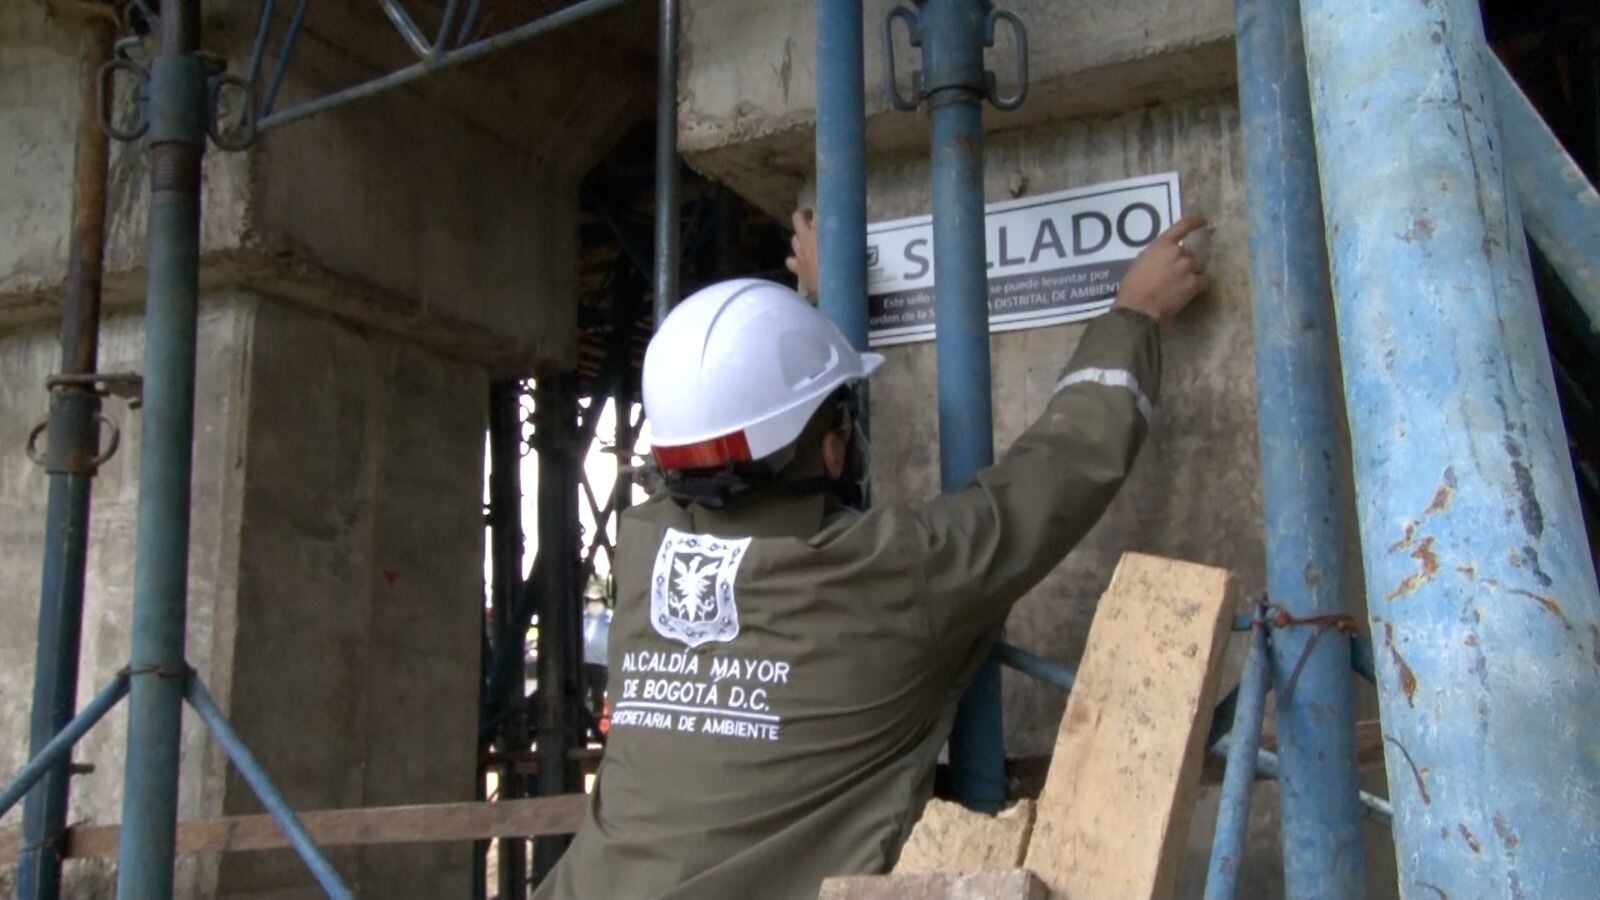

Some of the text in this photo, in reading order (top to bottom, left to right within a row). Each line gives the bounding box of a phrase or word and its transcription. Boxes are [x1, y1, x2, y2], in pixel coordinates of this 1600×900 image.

[903, 201, 1162, 280] SLADO
[1004, 279, 1039, 293] puede
[1042, 273, 1087, 287] levantar
[1090, 269, 1110, 283] por
[870, 314, 900, 326] orden
[901, 310, 915, 321] de
[917, 309, 927, 318] la
[995, 294, 1048, 309] DISTRITAL
[1051, 291, 1066, 302] DE
[1070, 281, 1121, 299] AMBIENT
[622, 648, 790, 683] ALCALDÍA MAYOR
[623, 677, 770, 711] DE BOGOTÁ D.C.
[612, 709, 779, 740] SECRETARIA DE AMBIENTE
